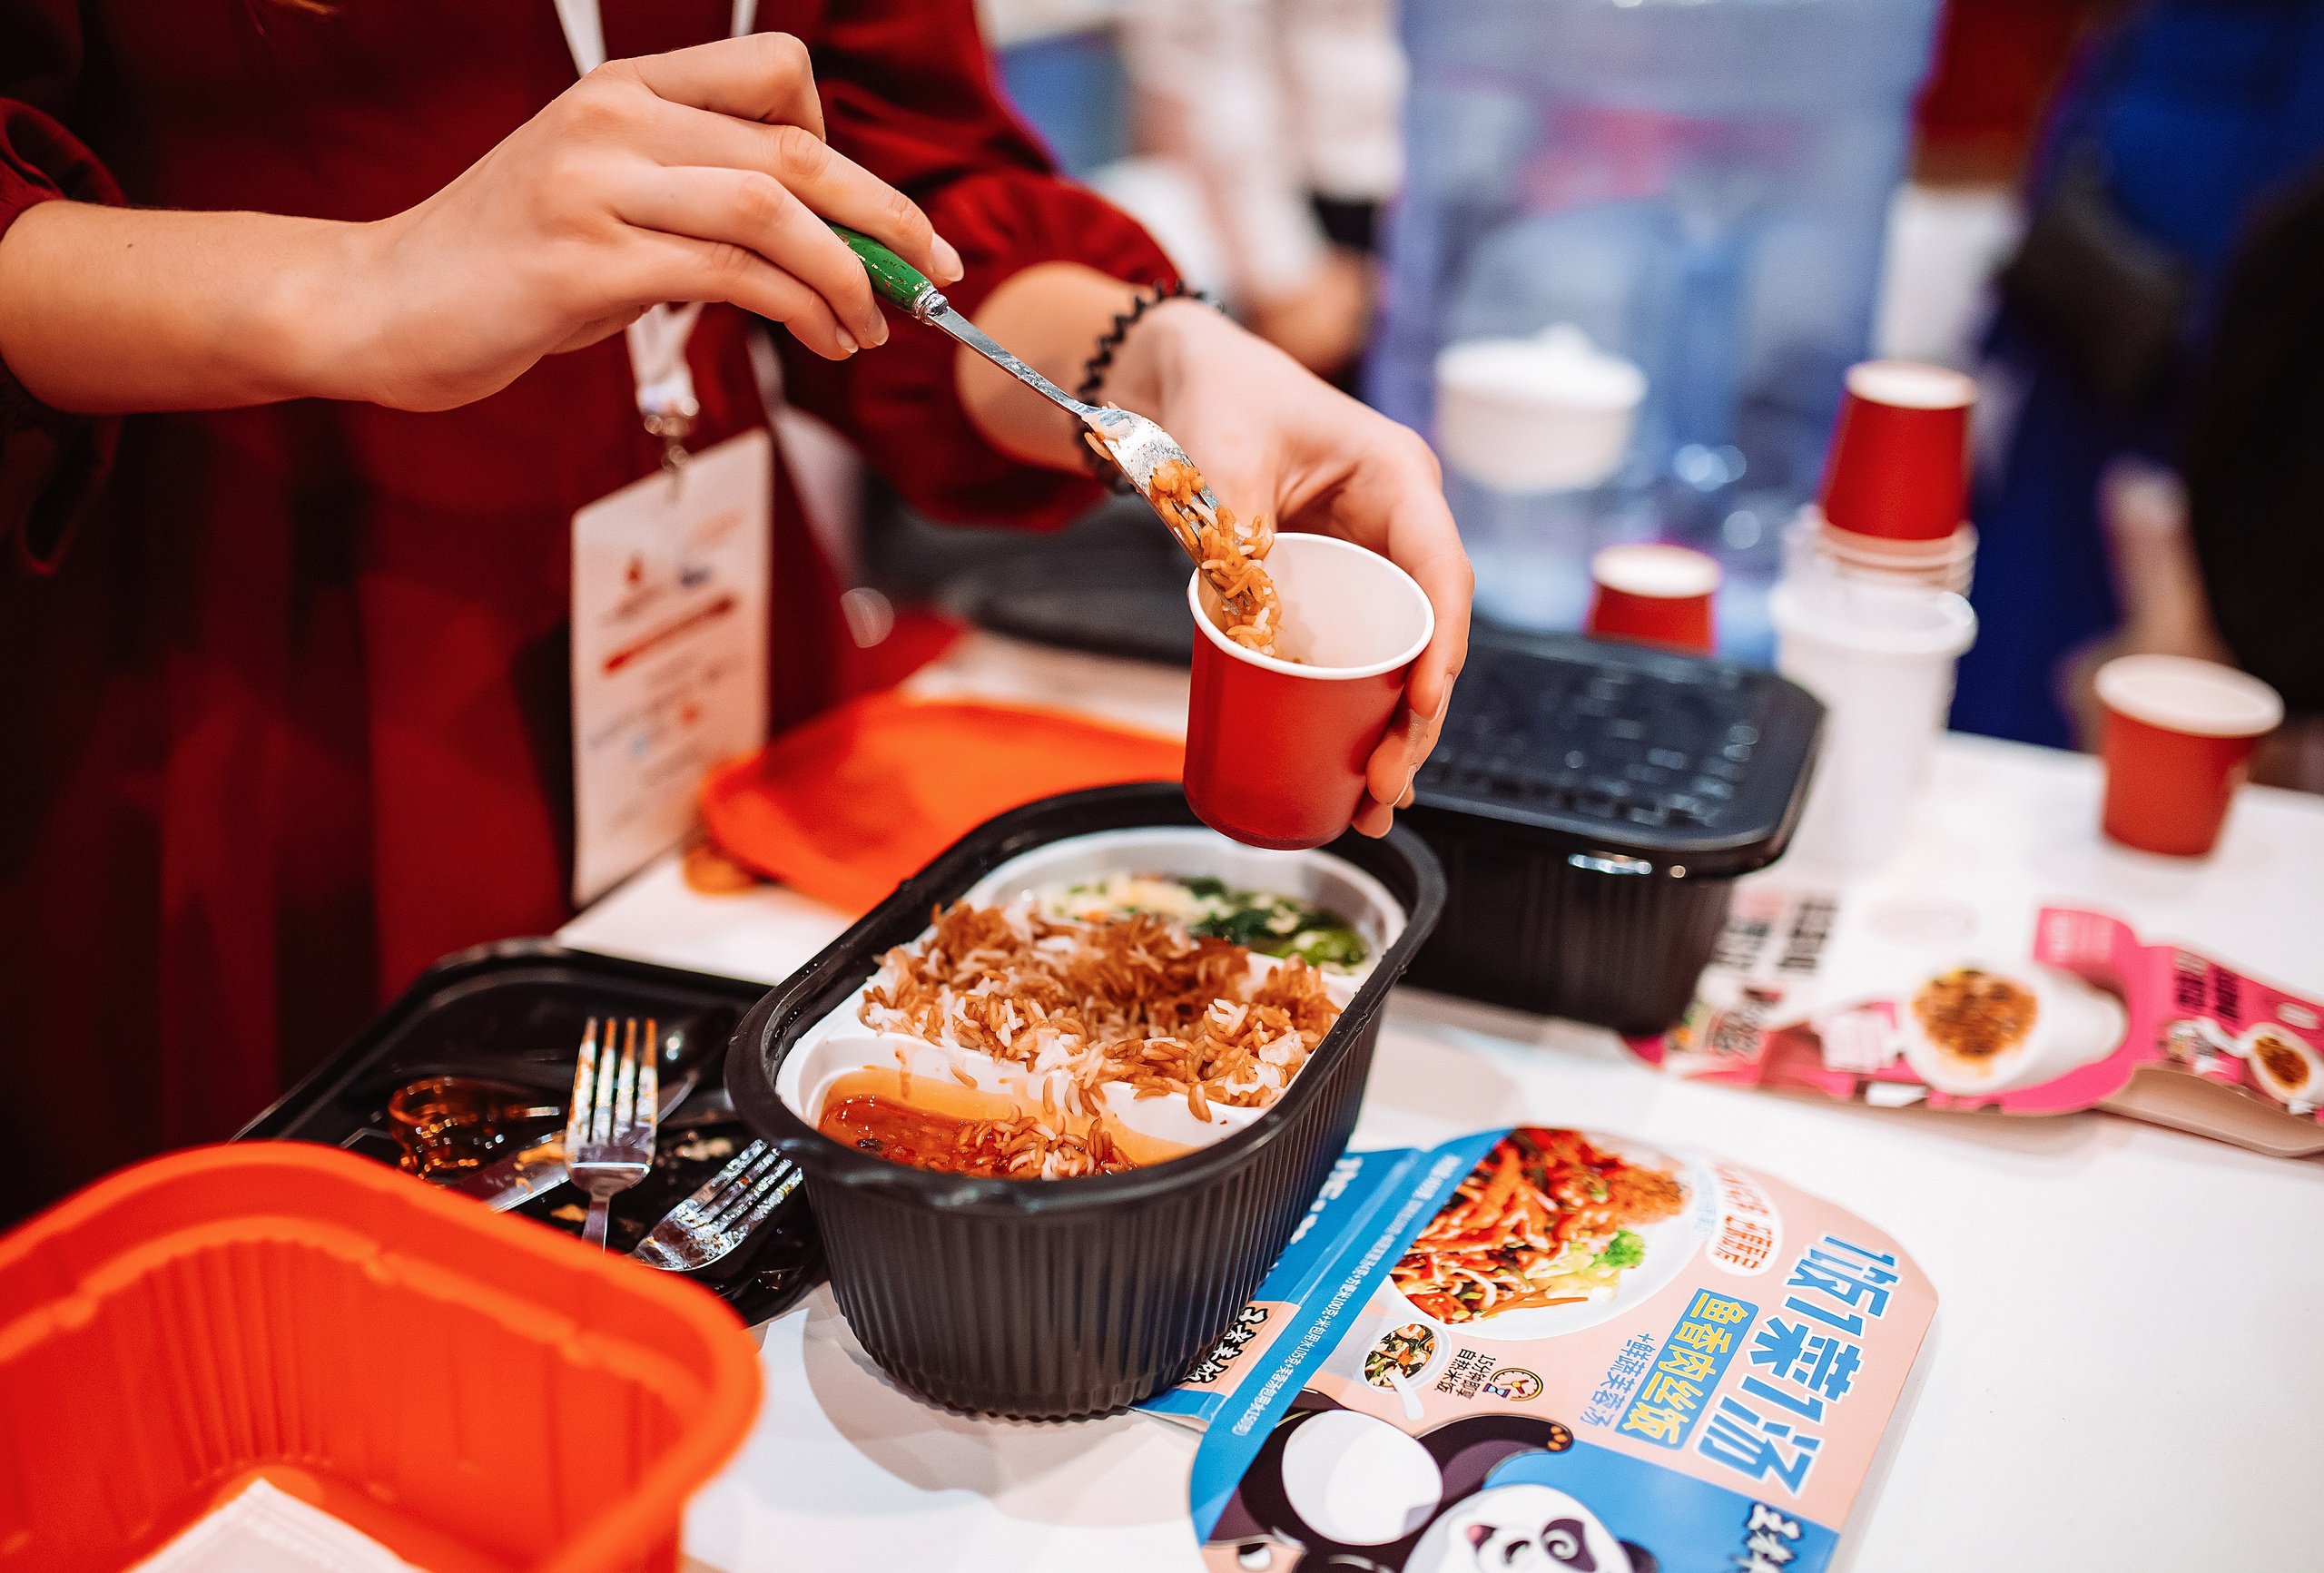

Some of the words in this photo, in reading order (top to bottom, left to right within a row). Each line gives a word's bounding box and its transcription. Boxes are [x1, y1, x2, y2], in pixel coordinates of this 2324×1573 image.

[1434, 1348, 1477, 1395] 自热米饭
[1455, 1353, 1497, 1401] 15分钟即享
[1579, 1332, 1657, 1428] +鲜蔬芙蓉汤
[1621, 1293, 1749, 1445] 鱼香肉丝饭
[1696, 1234, 1902, 1496] 1饭1菜1汤
